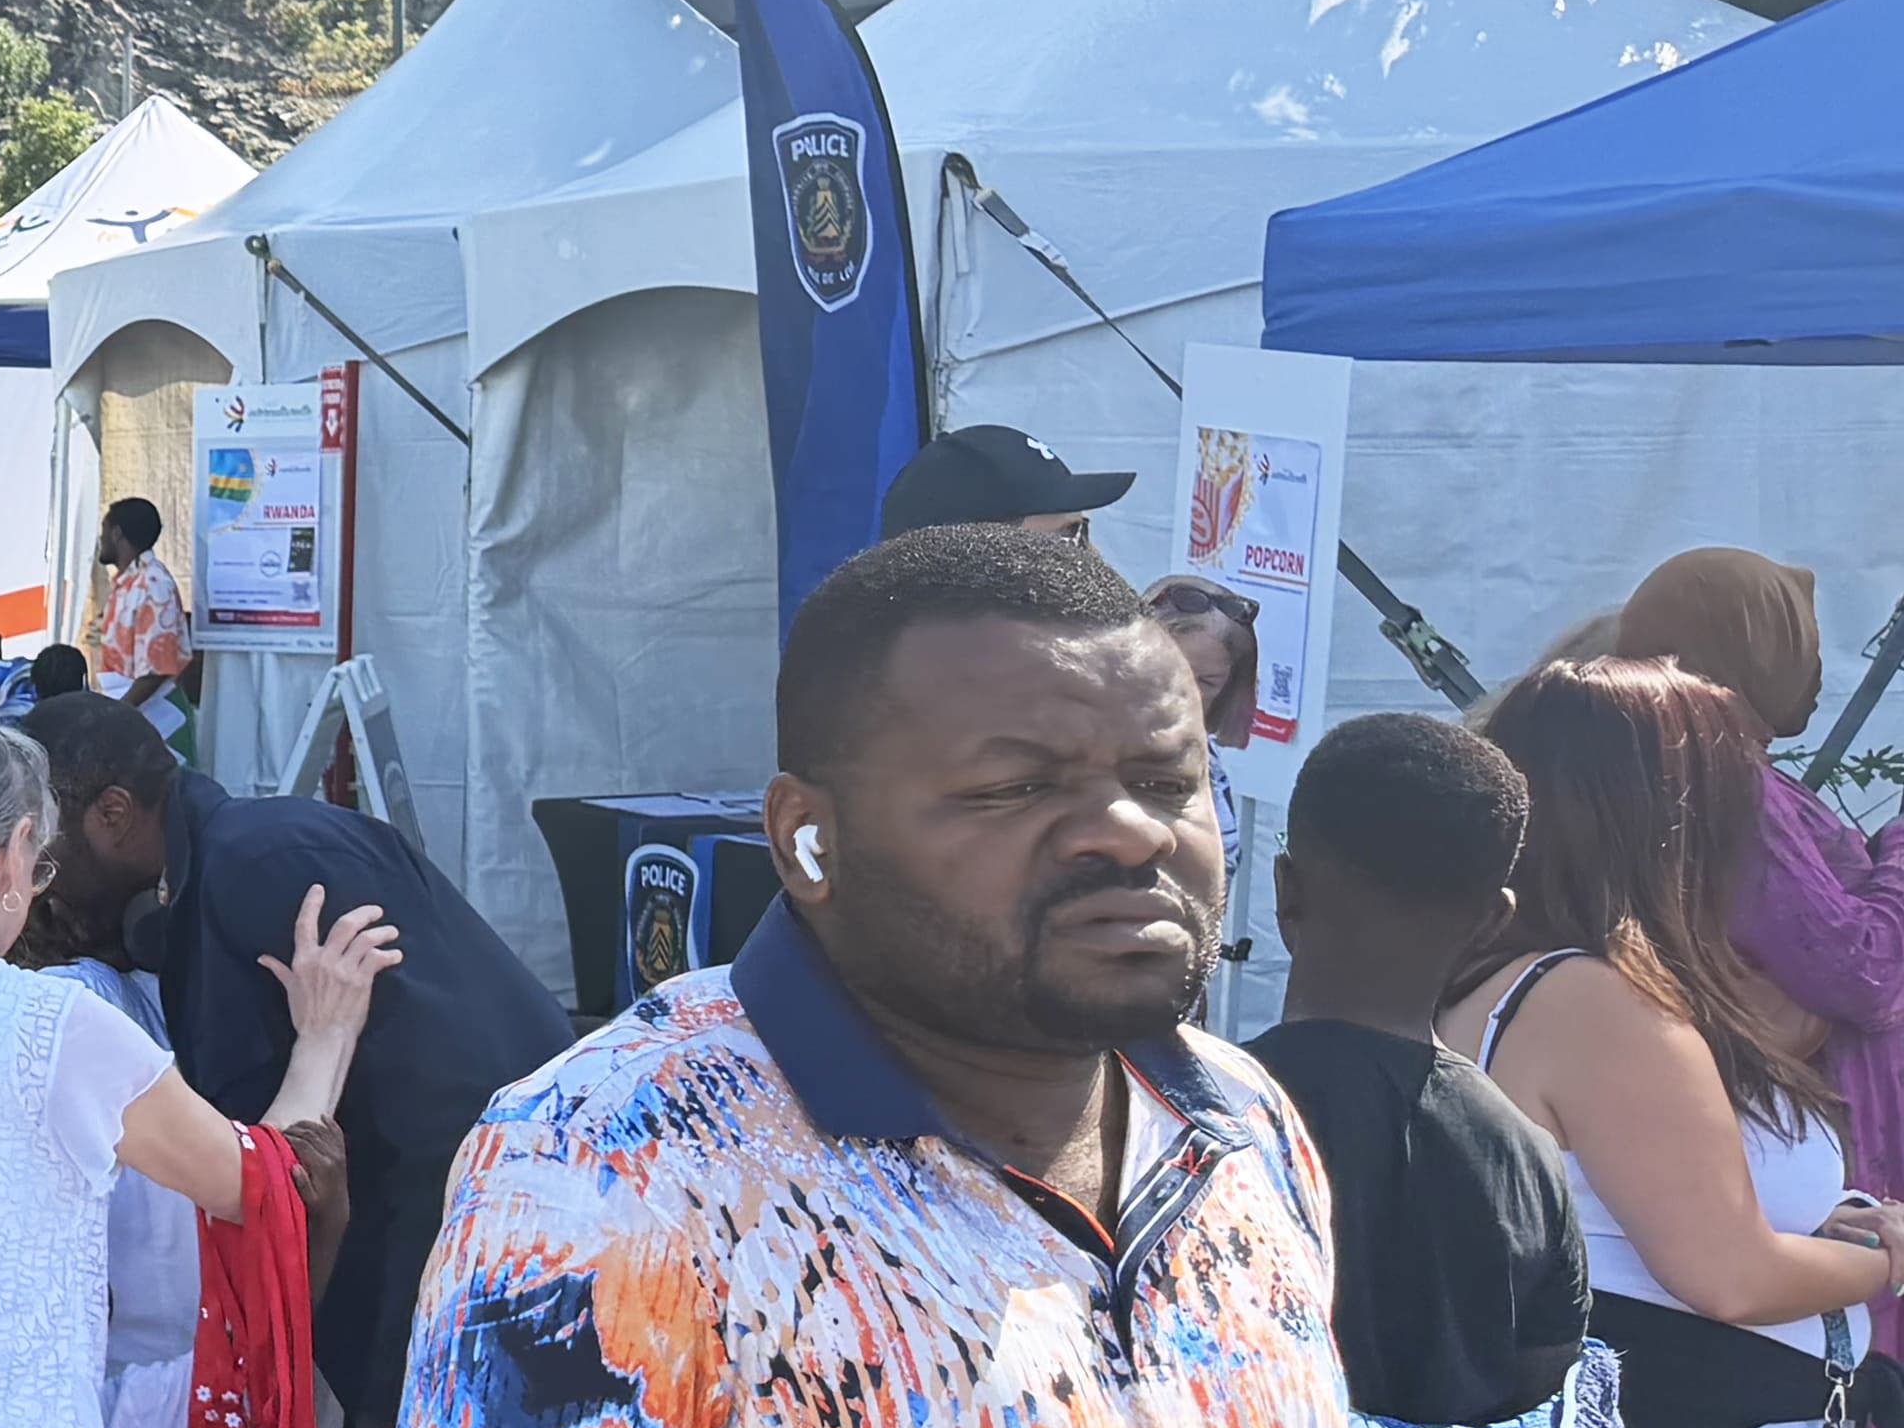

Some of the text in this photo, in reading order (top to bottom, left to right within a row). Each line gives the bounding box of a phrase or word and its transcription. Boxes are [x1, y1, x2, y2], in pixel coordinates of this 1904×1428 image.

[790, 133, 849, 162] POLICE
[263, 504, 316, 520] RWANDA
[1244, 544, 1305, 578] POPCORN
[640, 862, 687, 897] POLICE
